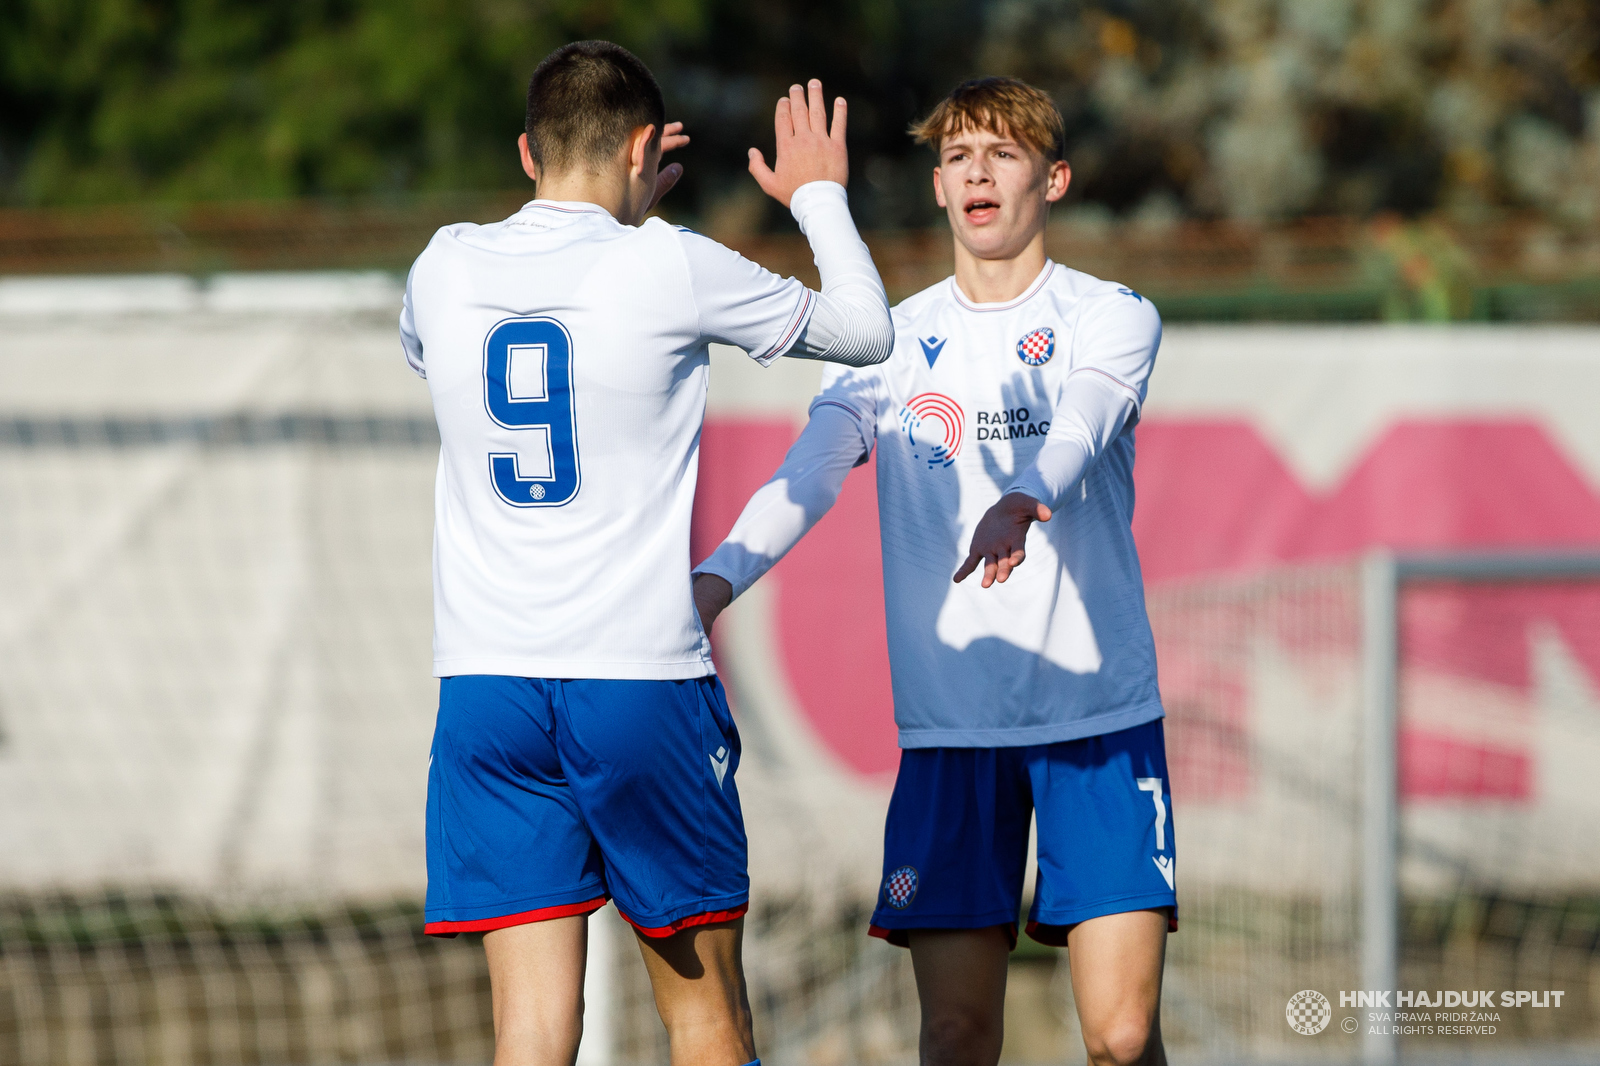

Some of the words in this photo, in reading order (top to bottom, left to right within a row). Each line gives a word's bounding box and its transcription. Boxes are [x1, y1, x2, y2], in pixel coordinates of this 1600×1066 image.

[1024, 353, 1050, 365] SPLIT
[482, 316, 582, 508] 9
[977, 407, 1029, 425] RADIO
[1136, 777, 1166, 850] 7
